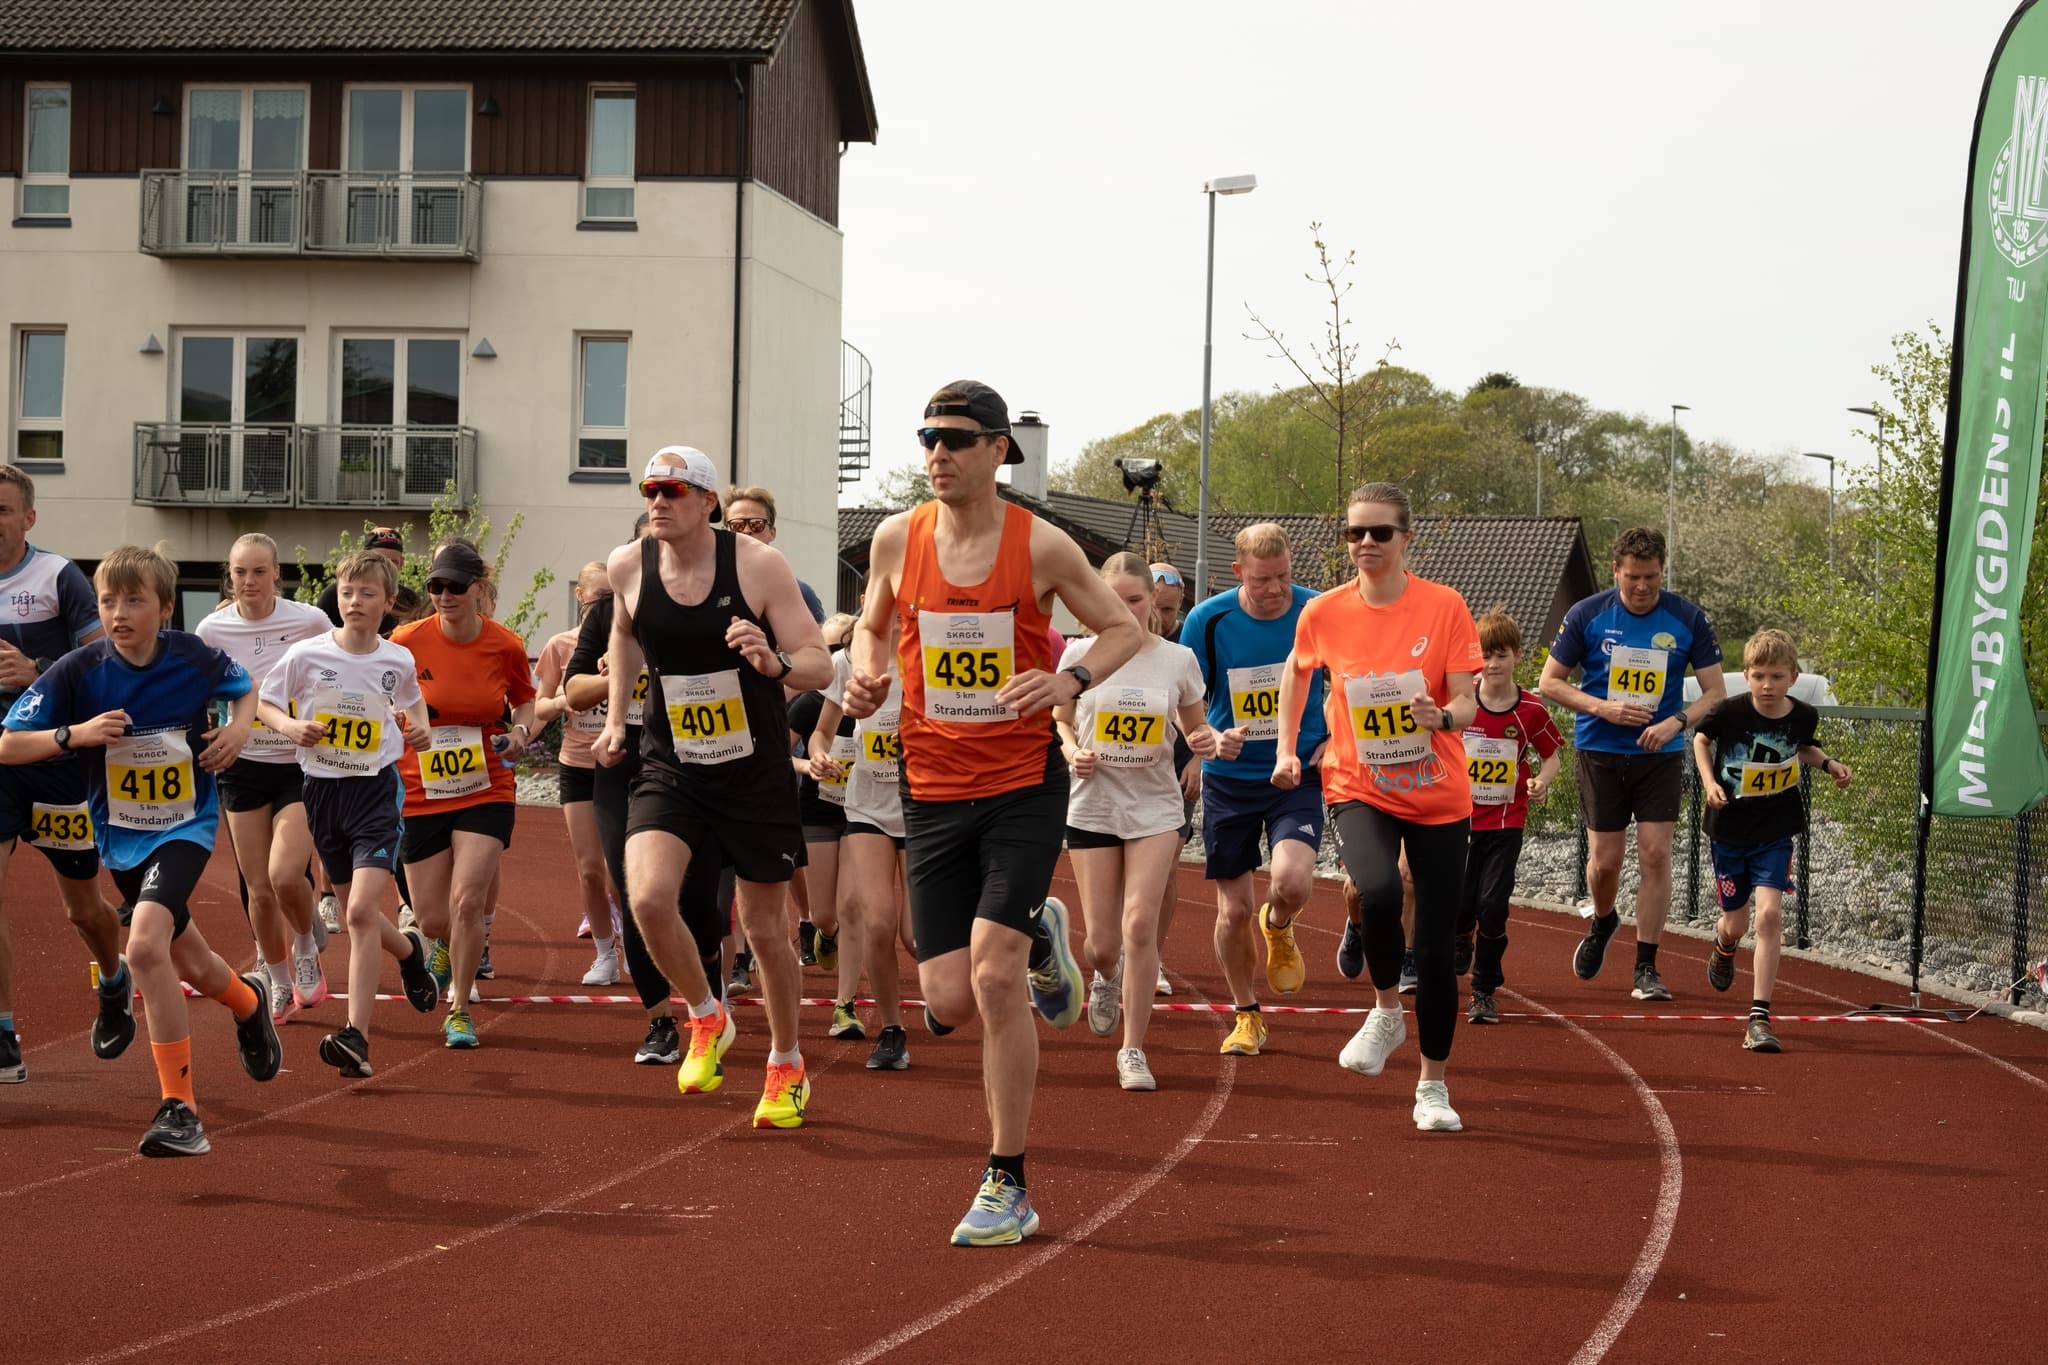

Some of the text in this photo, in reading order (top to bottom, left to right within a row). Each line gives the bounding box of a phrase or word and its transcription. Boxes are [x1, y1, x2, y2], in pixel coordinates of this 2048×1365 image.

[936, 651, 1000, 688] 435
[1617, 669, 1656, 693] 416
[685, 689, 716, 697] SKAGEN
[963, 691, 976, 699] km
[1370, 690, 1402, 699] SKAGEN
[337, 703, 366, 712] SKAGEN
[934, 703, 1006, 717] Strandamila
[681, 703, 731, 736] 401
[1104, 715, 1155, 742] 437
[1363, 704, 1418, 737] 415
[322, 718, 372, 749] 419
[132, 750, 168, 759] SKAGEN
[430, 747, 476, 777] 402
[685, 744, 744, 760] Strandamila
[1100, 753, 1154, 763] Strandamila
[1366, 746, 1425, 761] Strandamila
[316, 755, 370, 772] Strandamila
[1468, 760, 1508, 784] 422
[120, 766, 181, 800] 418
[1751, 766, 1793, 791] 417
[36, 813, 88, 840] 433
[119, 812, 185, 825] Strandamila
